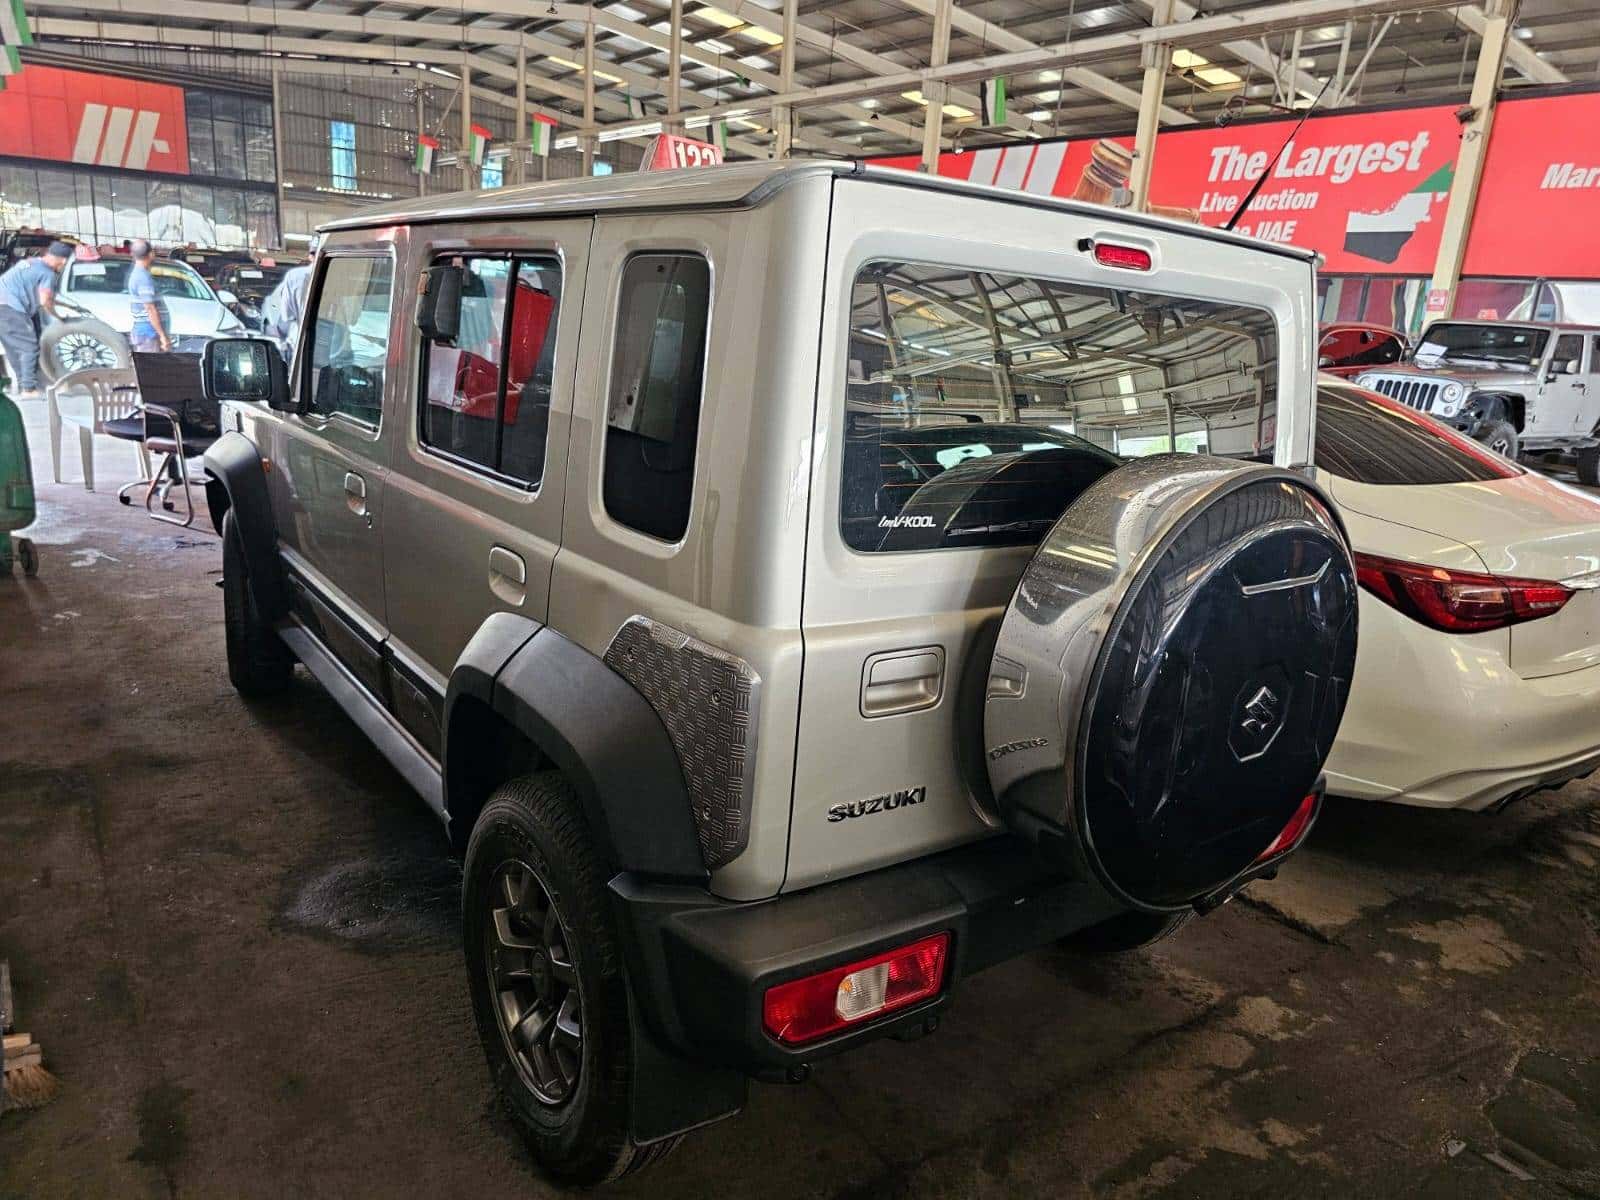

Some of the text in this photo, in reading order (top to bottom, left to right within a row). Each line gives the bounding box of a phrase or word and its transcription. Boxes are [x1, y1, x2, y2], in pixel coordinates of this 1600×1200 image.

[1208, 131, 1430, 184] The Largest
[1539, 162, 1600, 189] Mar
[1199, 191, 1238, 213] Live
[827, 786, 926, 823] SUZUKI
